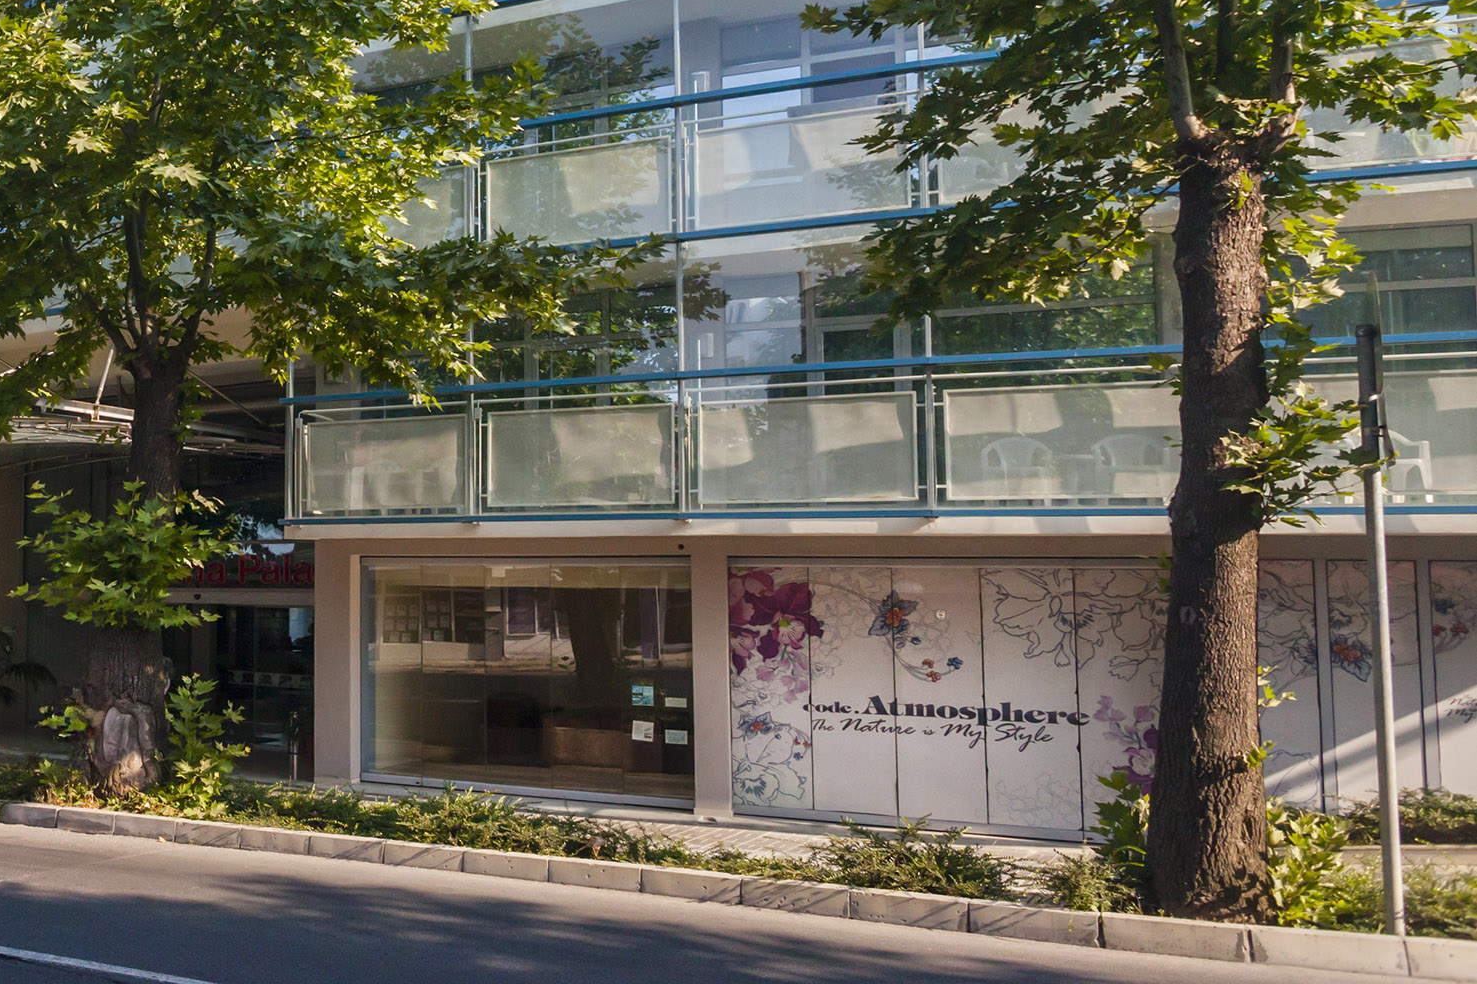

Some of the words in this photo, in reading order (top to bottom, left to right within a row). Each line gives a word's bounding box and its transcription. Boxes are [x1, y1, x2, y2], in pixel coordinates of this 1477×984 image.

[811, 719, 835, 731] The
[840, 718, 916, 735] Nature
[923, 726, 936, 735] is
[940, 723, 985, 749] My
[994, 723, 1054, 752] Style
